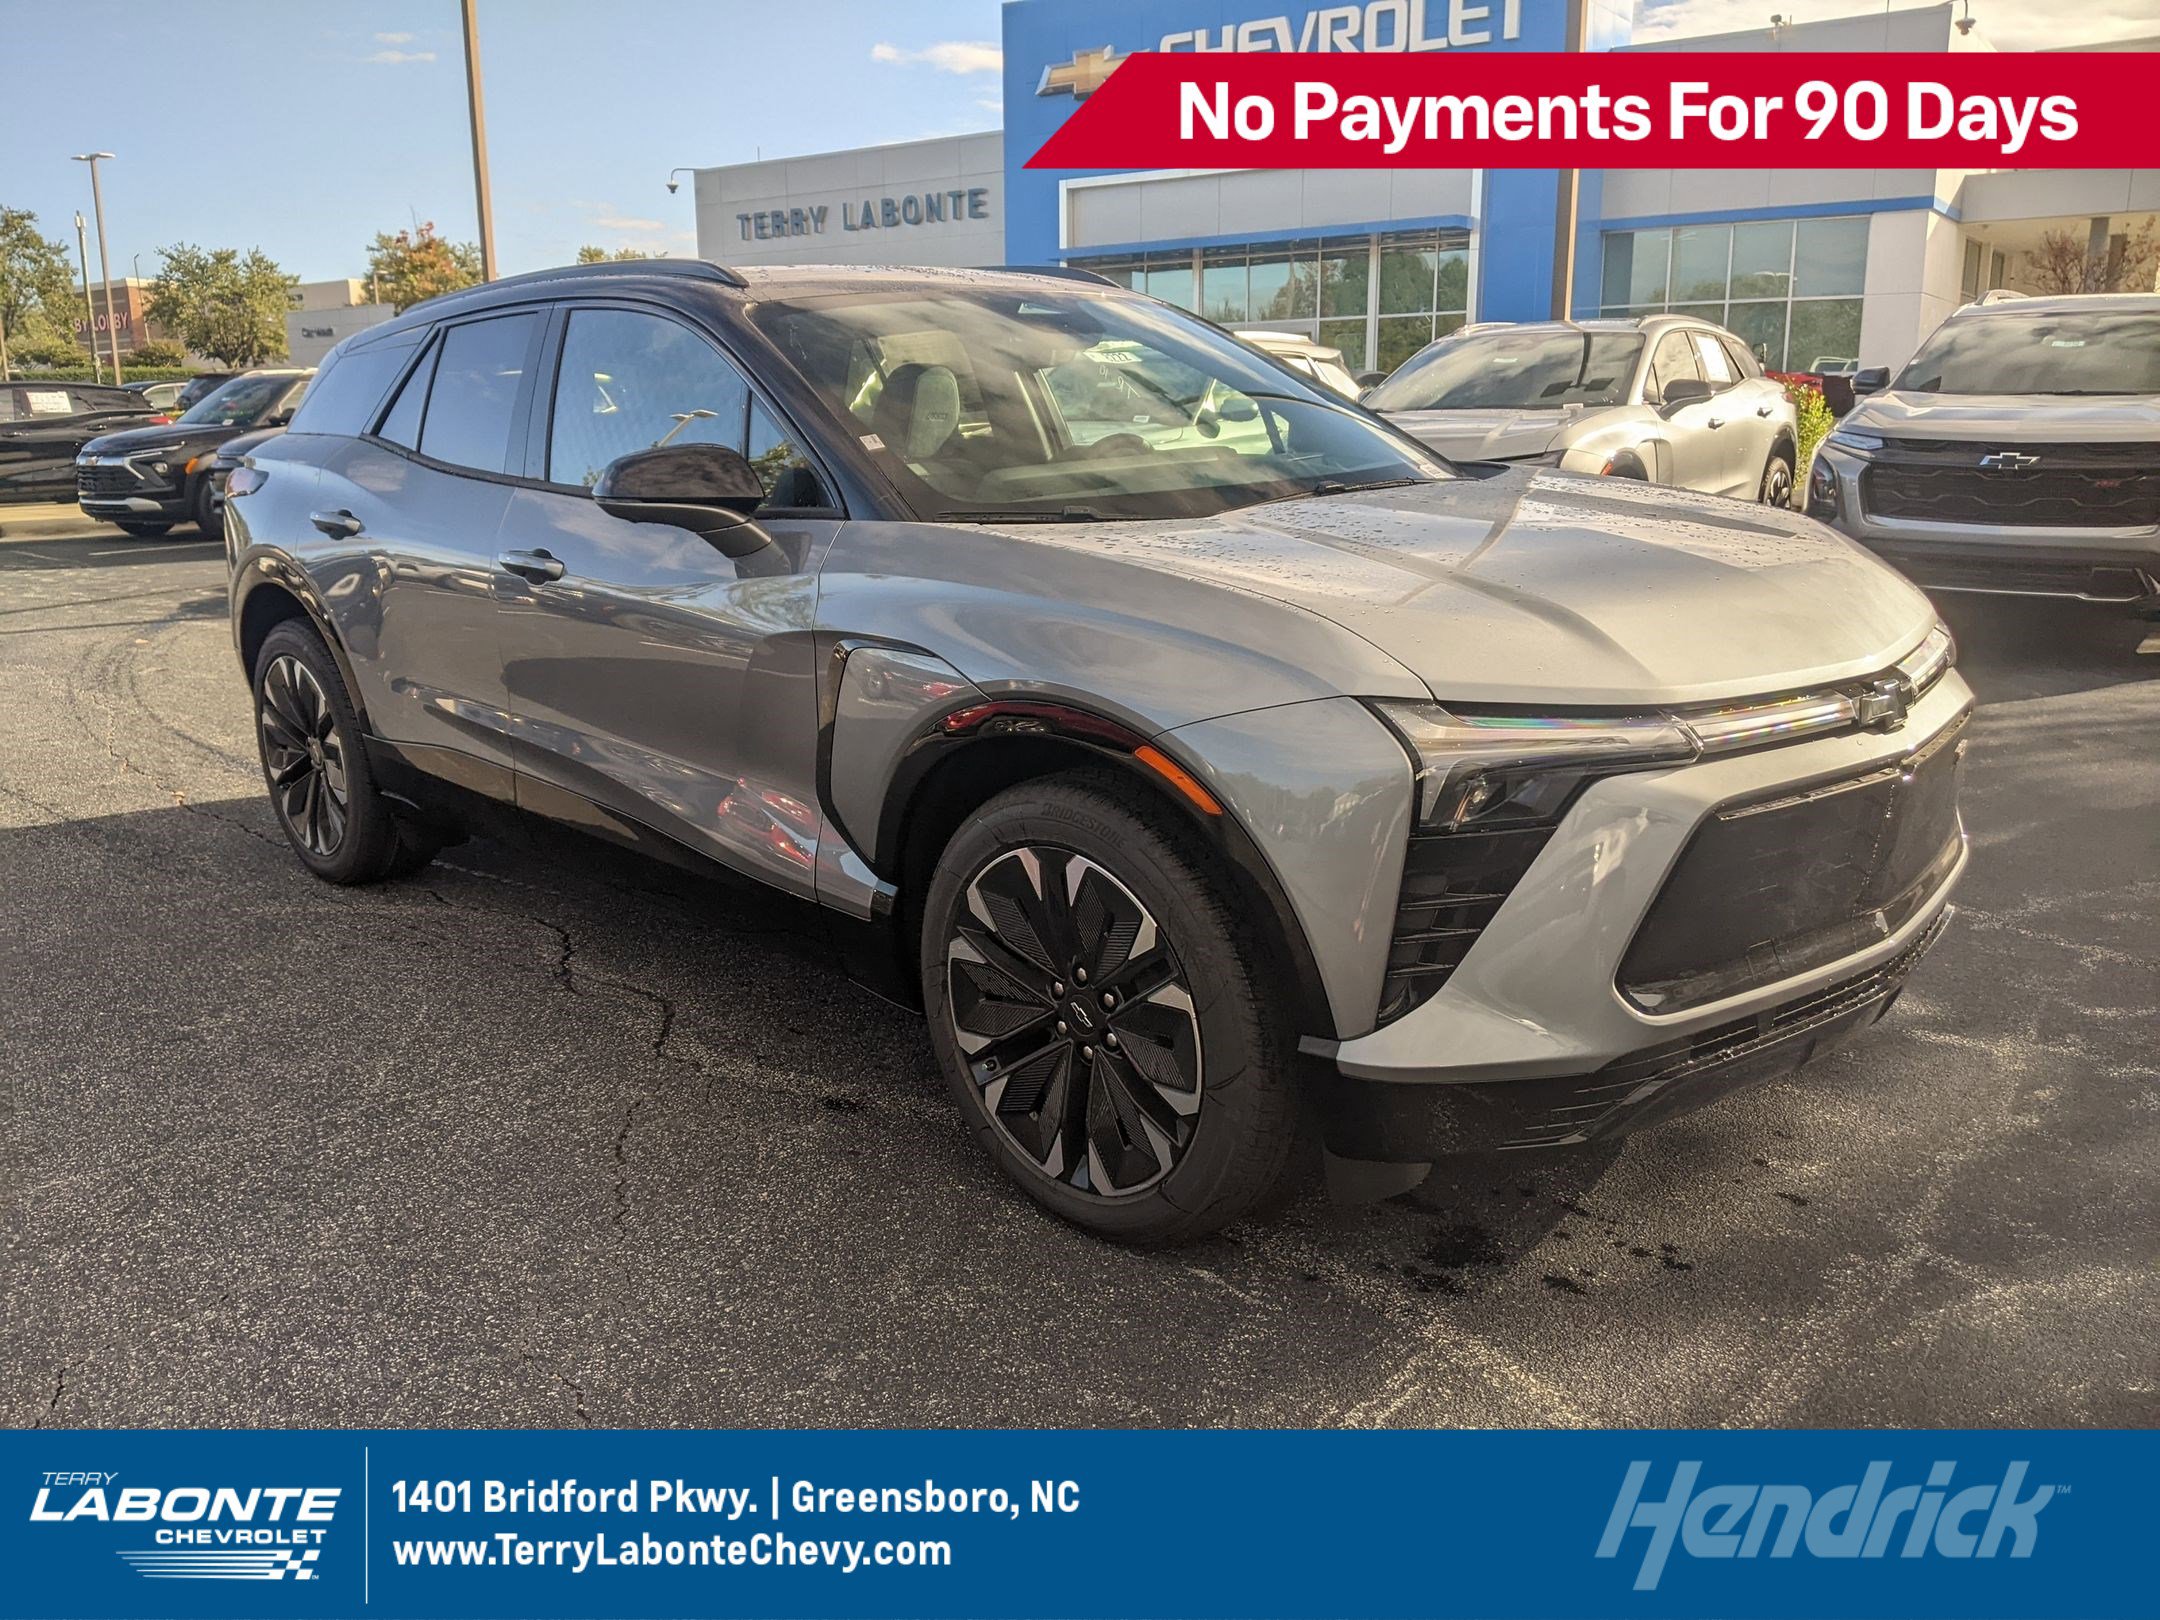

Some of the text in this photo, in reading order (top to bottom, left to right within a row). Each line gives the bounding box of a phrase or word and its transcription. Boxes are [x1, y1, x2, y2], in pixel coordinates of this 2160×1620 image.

[736, 187, 990, 241] TERRY LABONTE
[1041, 802, 1126, 849] BRIDGESTONE
